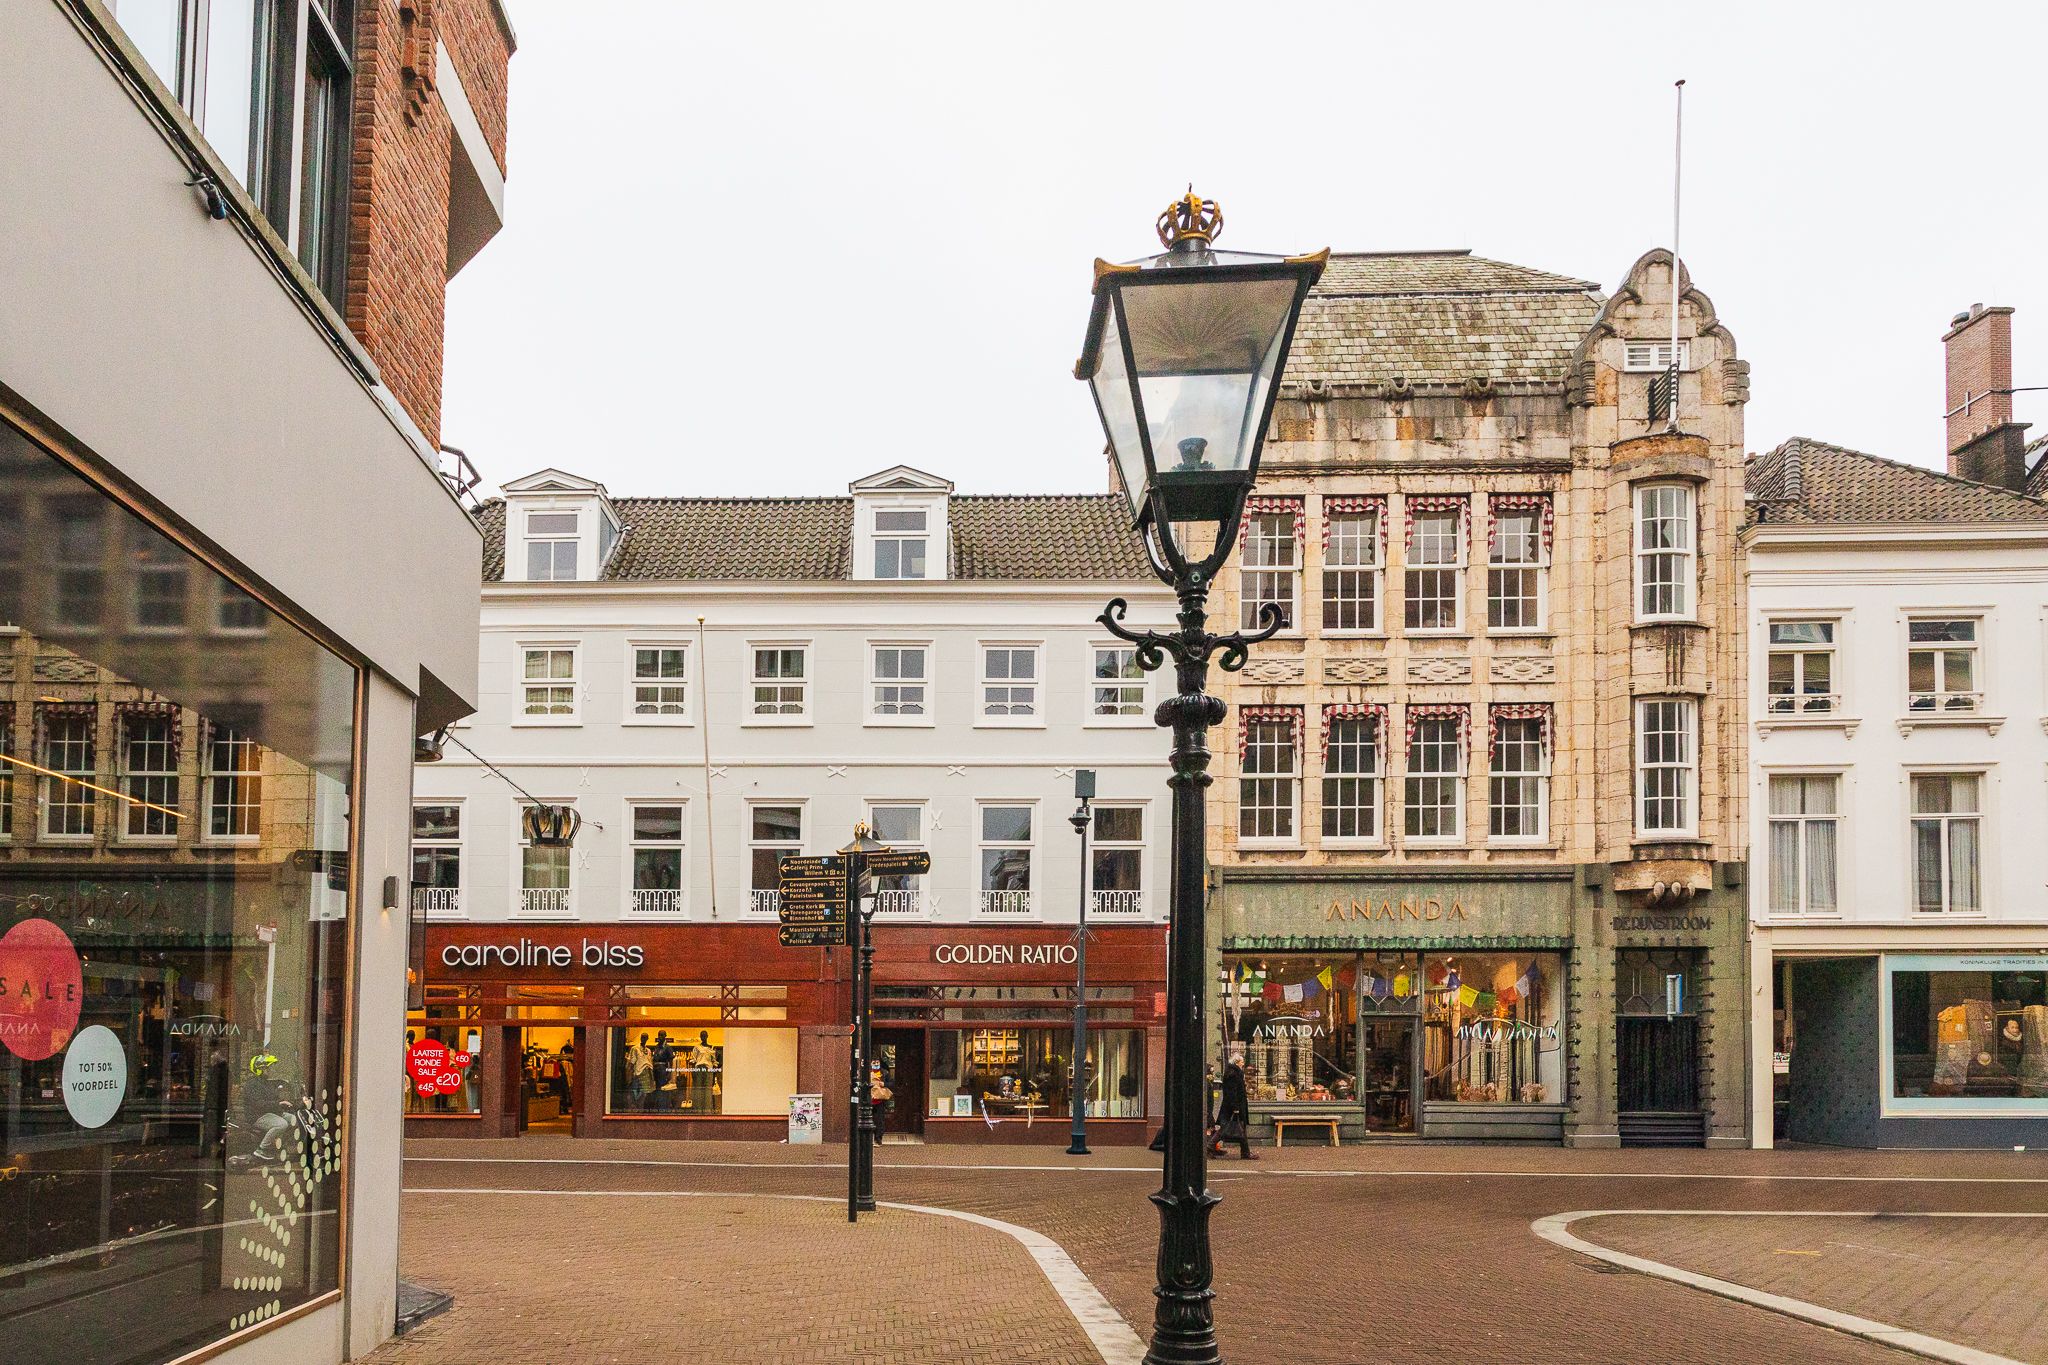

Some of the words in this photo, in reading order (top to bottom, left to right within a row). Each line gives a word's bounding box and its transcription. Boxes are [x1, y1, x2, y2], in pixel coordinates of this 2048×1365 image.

[1326, 898, 1468, 921] ANANDA
[442, 937, 572, 967] caroline
[582, 937, 644, 967] biss
[935, 944, 1014, 964] GOLDEN
[1021, 944, 1078, 964] RATIO
[0, 977, 75, 1001] SALE
[1252, 1024, 1325, 1037] ANANDA
[79, 1063, 95, 1072] TOT
[97, 1062, 113, 1072] 50%
[72, 1080, 118, 1092] VOORDEEL
[436, 1073, 460, 1086] €20
[418, 1083, 434, 1092] €45
